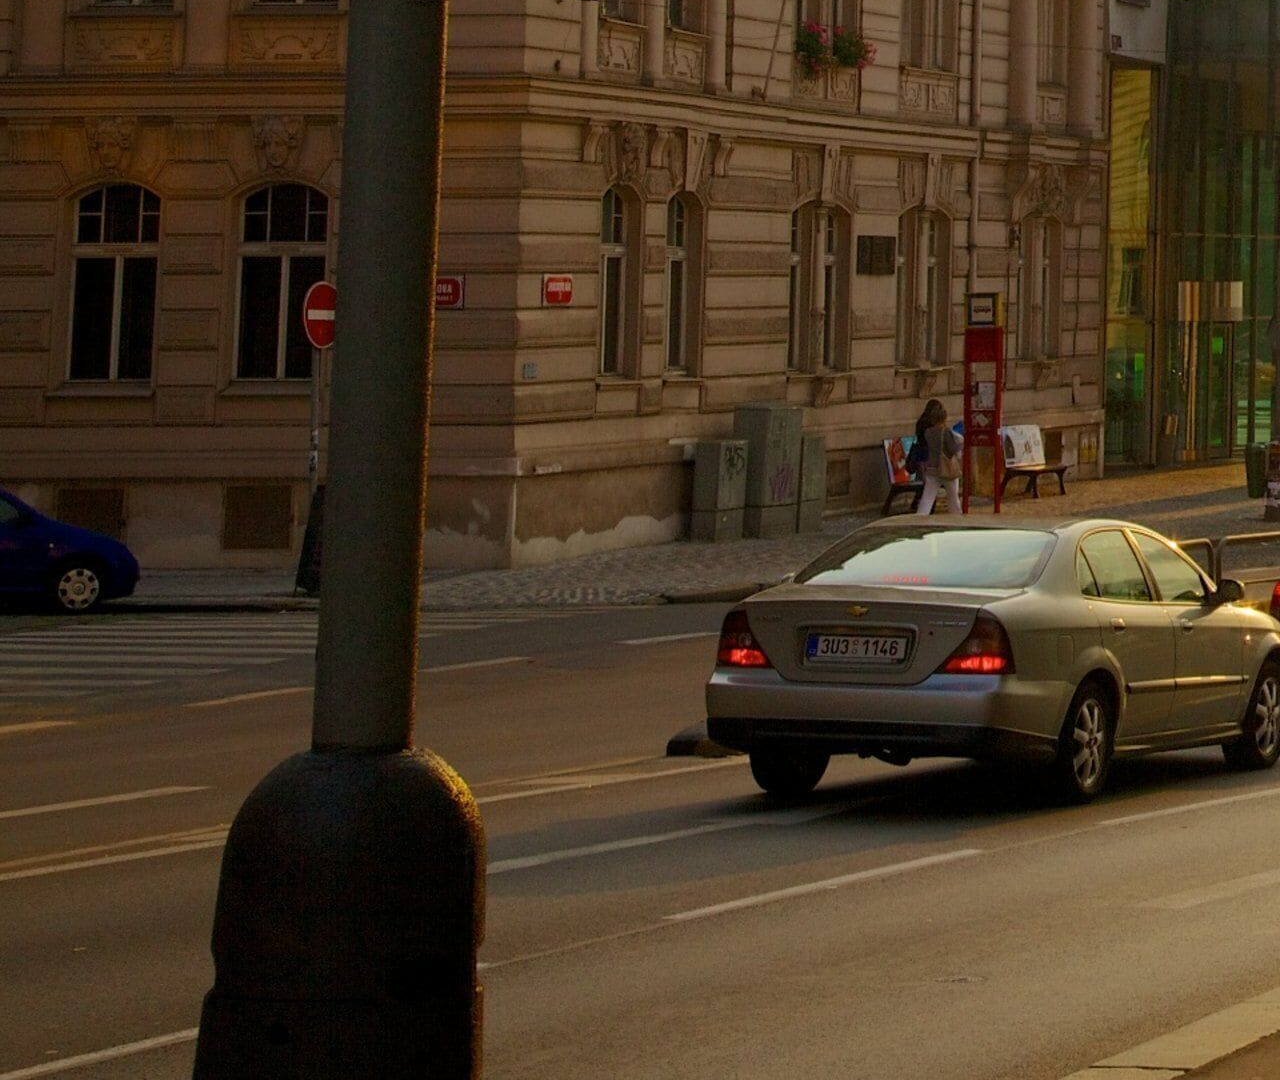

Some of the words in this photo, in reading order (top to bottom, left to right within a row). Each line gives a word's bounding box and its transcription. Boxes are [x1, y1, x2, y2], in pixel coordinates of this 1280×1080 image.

[436, 283, 453, 294] OVA
[821, 638, 850, 655] 3U3
[862, 638, 899, 656] 1146
